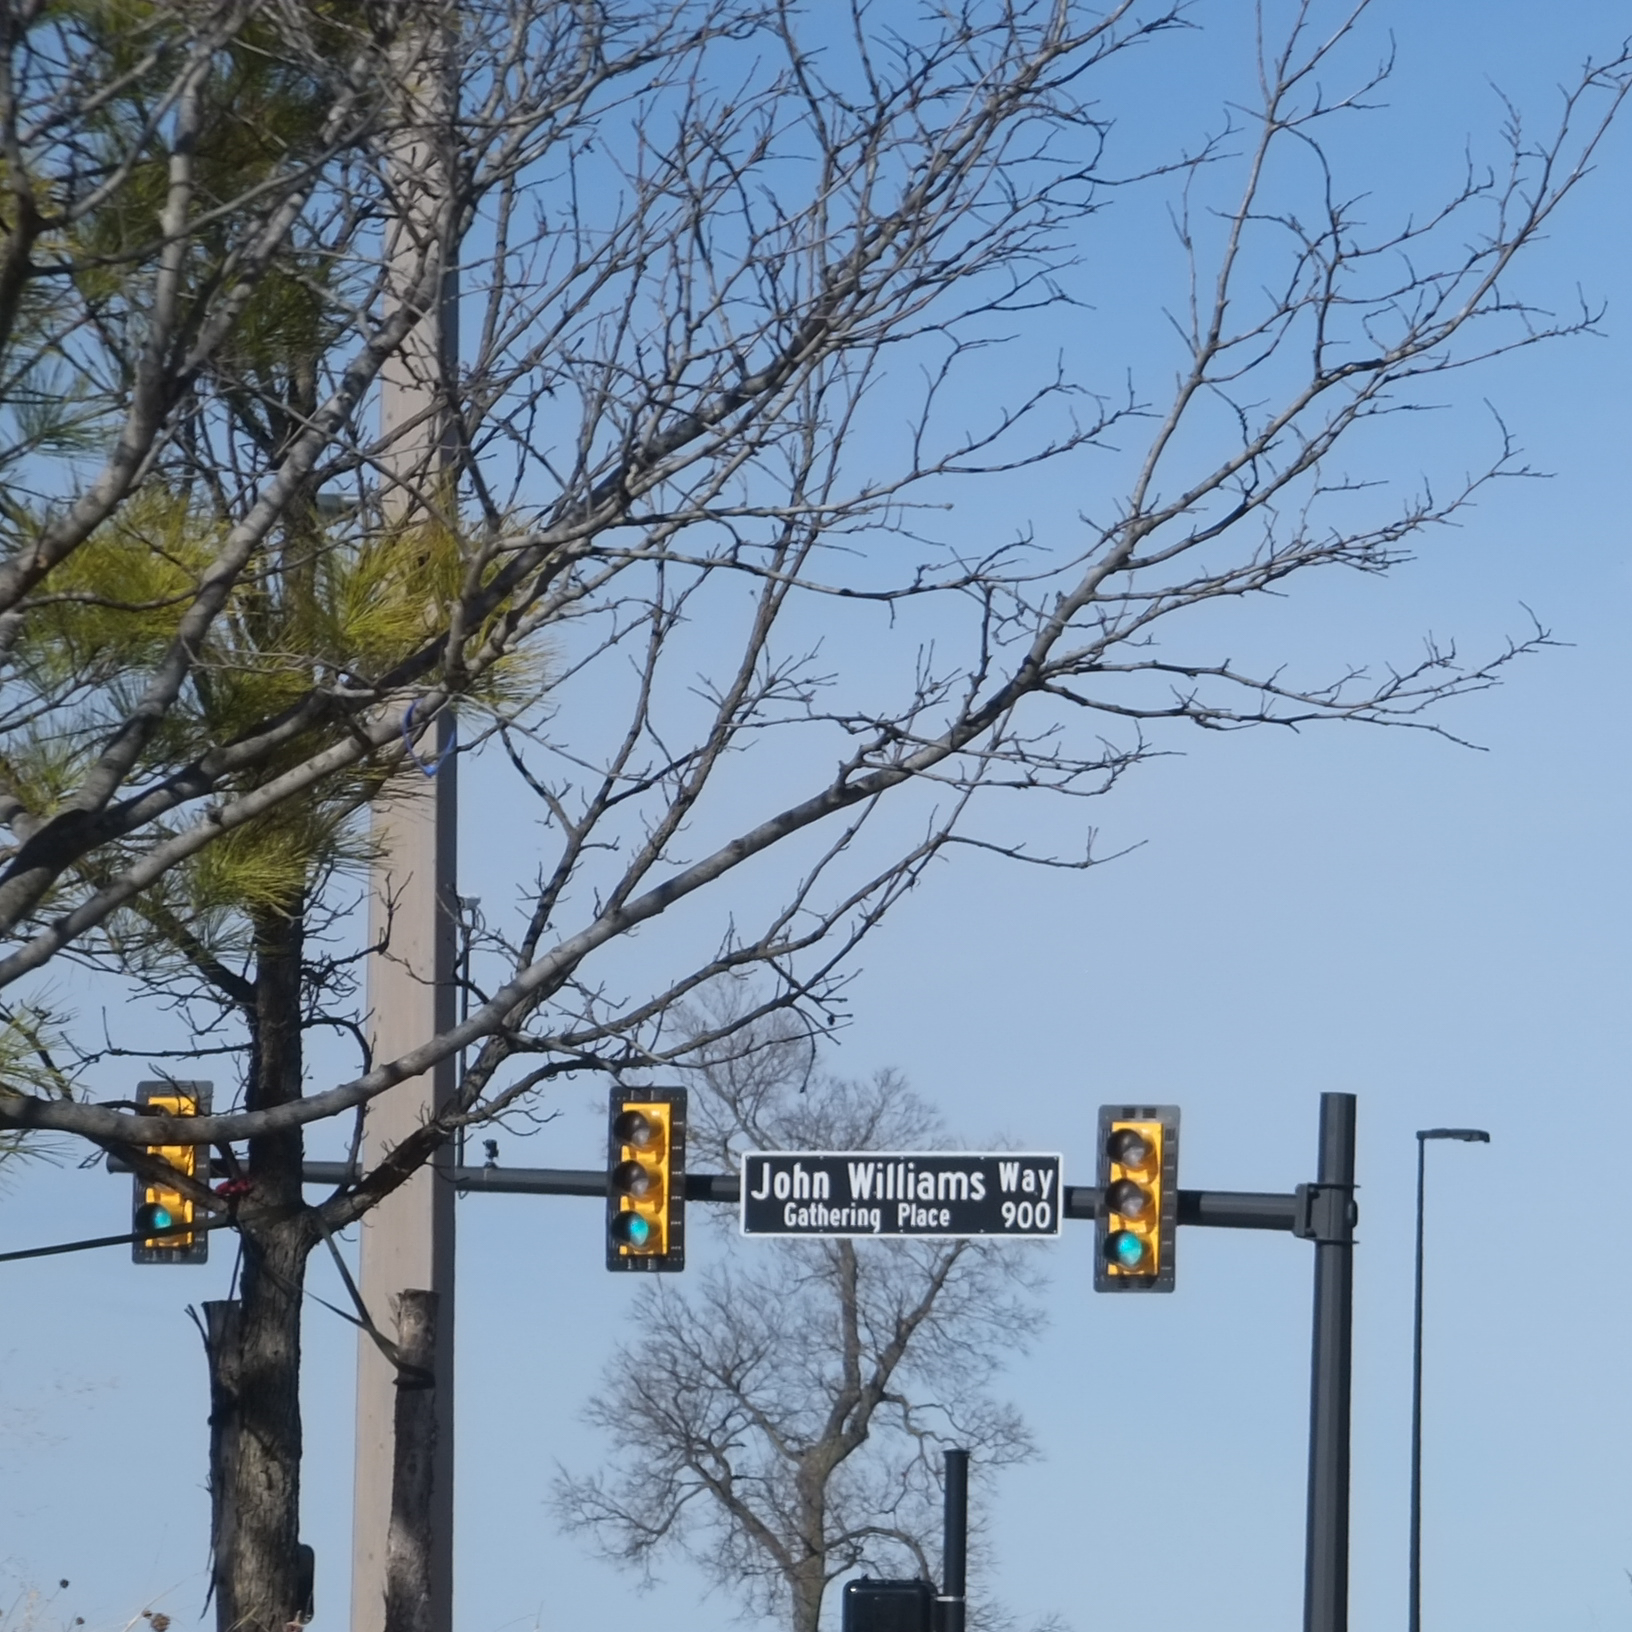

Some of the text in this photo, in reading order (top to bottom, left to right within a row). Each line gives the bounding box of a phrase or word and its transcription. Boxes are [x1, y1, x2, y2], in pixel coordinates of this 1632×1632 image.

[751, 1161, 1053, 1200] John Williams Way
[783, 1202, 950, 1233] Gathering Place
[1001, 1201, 1050, 1229] 900
